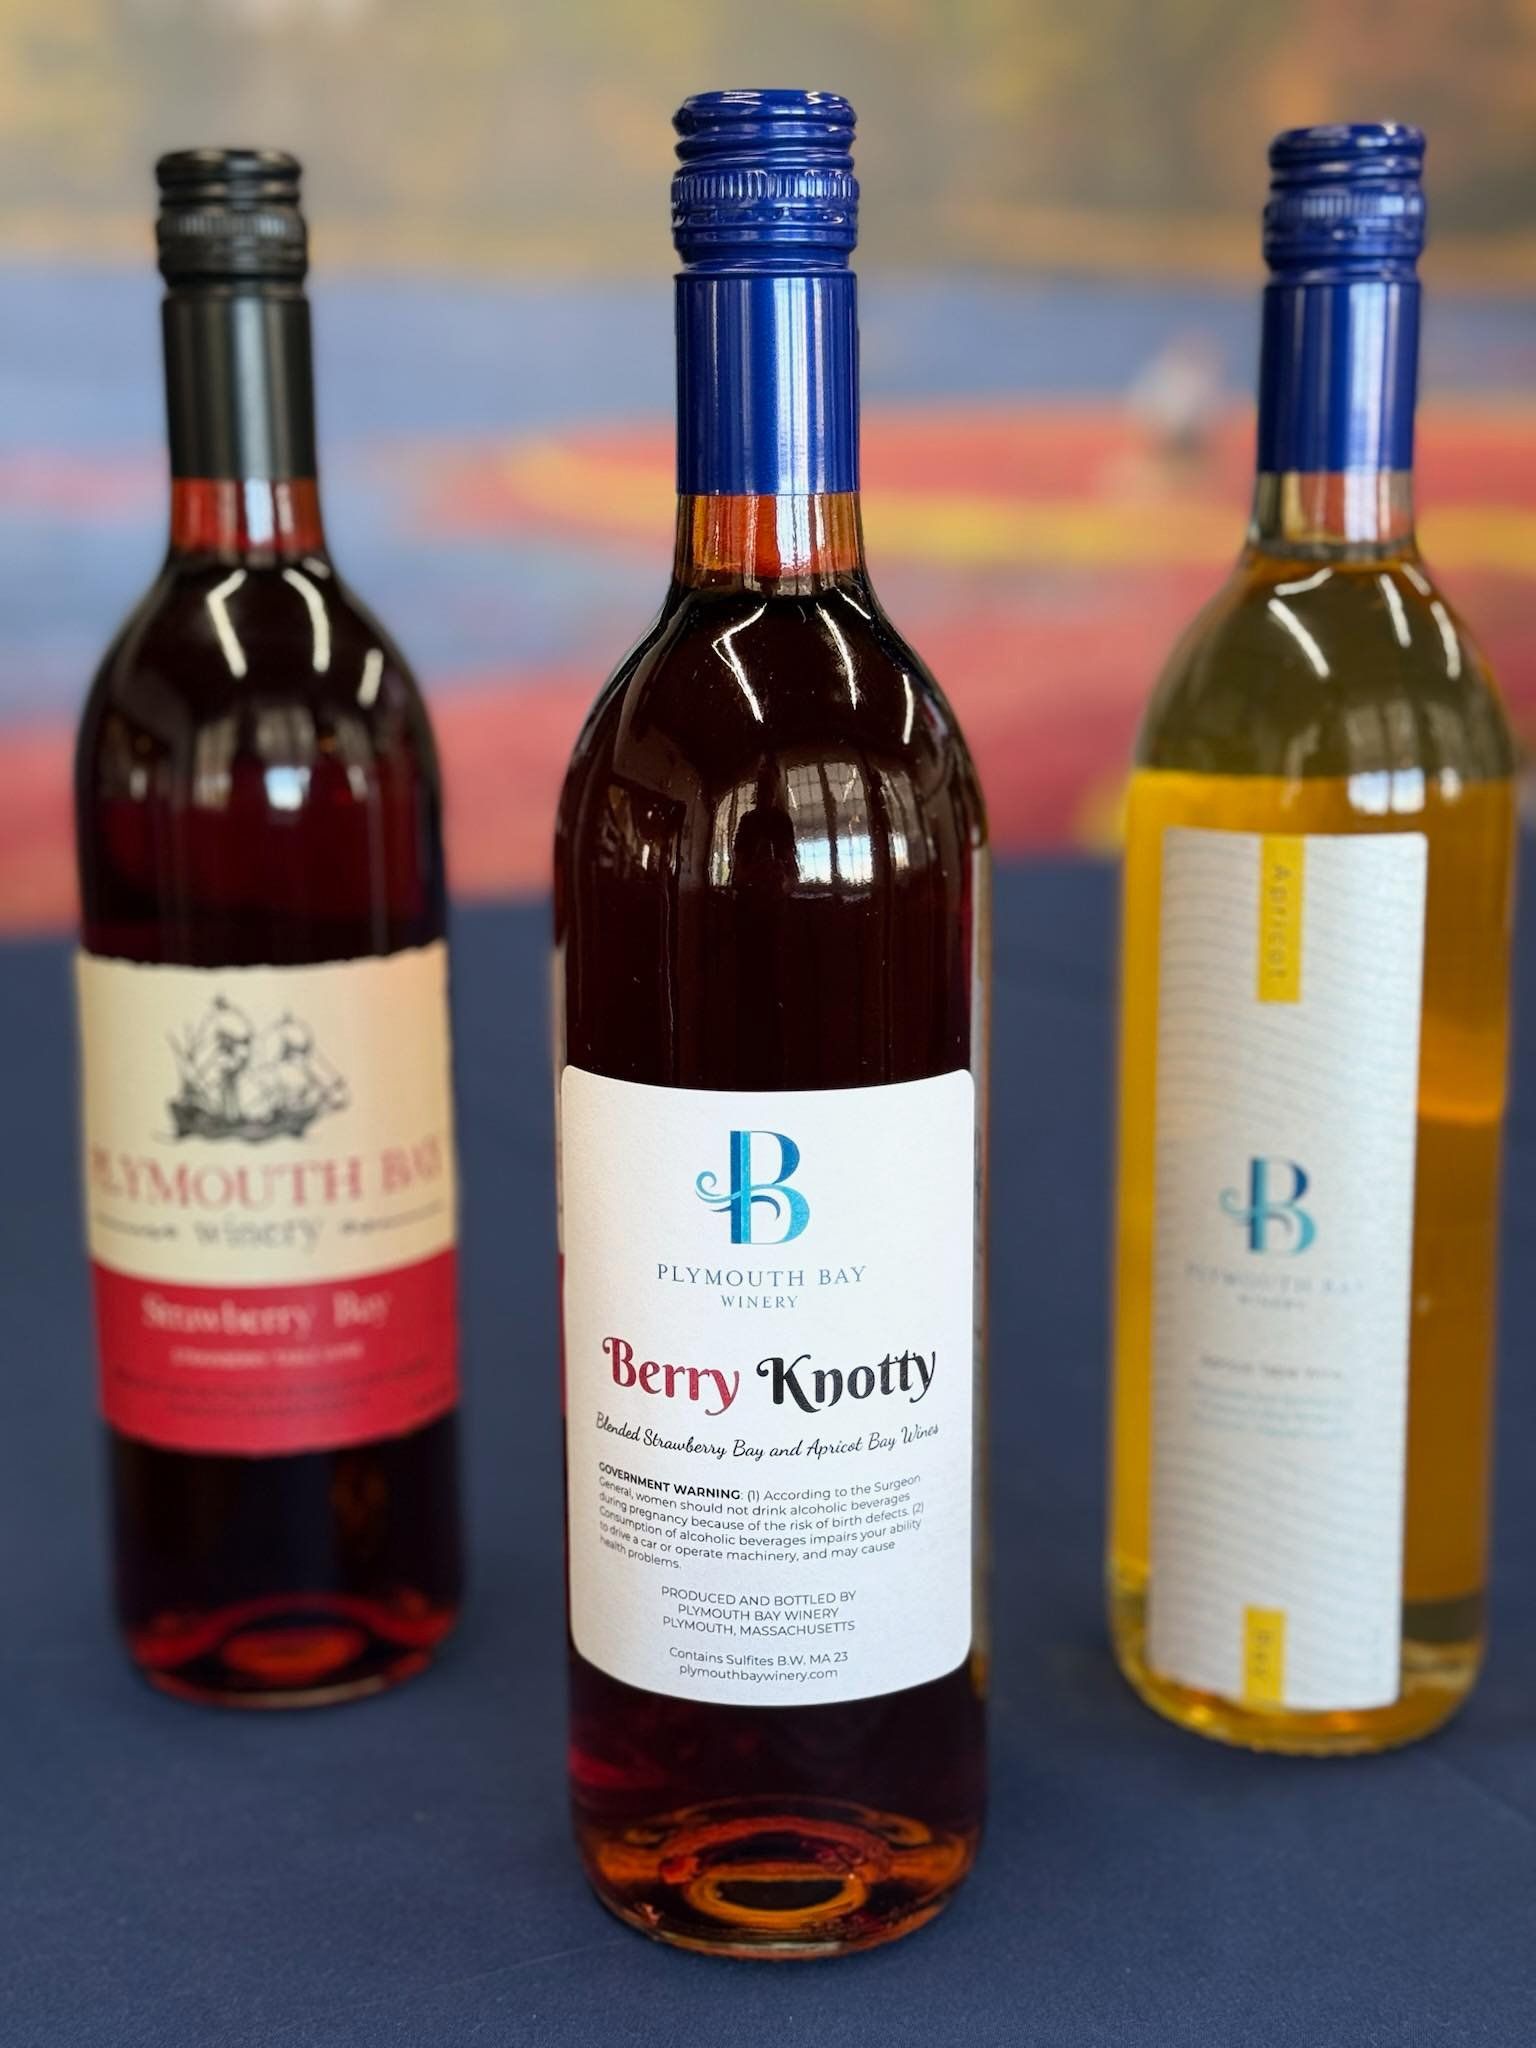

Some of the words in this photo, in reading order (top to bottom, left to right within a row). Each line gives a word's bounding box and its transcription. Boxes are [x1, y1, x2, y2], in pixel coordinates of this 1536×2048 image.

[695, 1130, 811, 1245] B
[657, 1264, 804, 1287] PLYMOUTH
[819, 1265, 867, 1285] BAY
[721, 1295, 799, 1310] WINERY
[602, 1337, 740, 1416] Berry
[756, 1349, 936, 1413] Knotty
[596, 1411, 640, 1442] Blended
[643, 1428, 727, 1460] Strawberry
[733, 1439, 764, 1461] Bay
[769, 1439, 803, 1457] and
[806, 1437, 863, 1460] Apricot
[868, 1431, 896, 1451] Bay
[901, 1424, 939, 1444] Wines
[598, 1461, 670, 1492] GOVERNMENT
[673, 1484, 743, 1500] WARNING:
[747, 1489, 760, 1502] (1)
[763, 1489, 831, 1501] According
[834, 1488, 847, 1497] to
[850, 1485, 871, 1496] the
[873, 1474, 921, 1492] Surgeon
[599, 1476, 634, 1498] General,
[636, 1493, 677, 1509] women
[680, 1500, 723, 1514] should
[727, 1506, 749, 1516] not
[752, 1504, 787, 1516] drink
[790, 1502, 847, 1515] alcoholic
[851, 1492, 911, 1511] beverages
[599, 1492, 627, 1510] during
[629, 1504, 688, 1527] pregnancy
[691, 1517, 744, 1530] because
[747, 1520, 761, 1531] of
[764, 1520, 786, 1531] the
[790, 1519, 812, 1530] risk
[816, 1518, 829, 1529] of
[832, 1515, 862, 1528] birth
[865, 1508, 909, 1523] defects.
[912, 1502, 924, 1515] (2)
[599, 1505, 662, 1536] Consumption
[665, 1526, 677, 1538] of
[679, 1530, 736, 1545] alcoholic
[739, 1535, 807, 1548] beverages
[810, 1532, 858, 1545] impairs
[860, 1528, 886, 1543] your
[889, 1519, 922, 1534] ability
[599, 1521, 609, 1532] to
[610, 1525, 631, 1541] drive
[632, 1536, 639, 1544] a
[640, 1537, 657, 1549] car
[660, 1543, 672, 1552] or
[675, 1545, 723, 1560] operate
[726, 1549, 799, 1563] machinery,
[802, 1548, 827, 1560] and
[831, 1548, 858, 1559] may
[861, 1541, 896, 1555] cause
[599, 1535, 626, 1553] health
[628, 1549, 682, 1570] problems.
[661, 1585, 736, 1605] PRODUCED
[739, 1595, 770, 1607] AND
[774, 1592, 836, 1607] BOTTLED
[839, 1590, 857, 1602] BY
[678, 1603, 750, 1621] PLYMOUTH
[754, 1610, 781, 1621] BAY
[784, 1607, 839, 1620] WINERY
[663, 1615, 737, 1636] PLYMOUTH,
[740, 1620, 856, 1636] MASSACHUSETTS
[669, 1647, 724, 1664] Contains
[726, 1654, 774, 1666] Sulfites
[777, 1655, 806, 1666] B.W.
[809, 1653, 831, 1664] MA
[833, 1651, 849, 1663] 23
[679, 1664, 838, 1683] plymouthbaywinery.com
